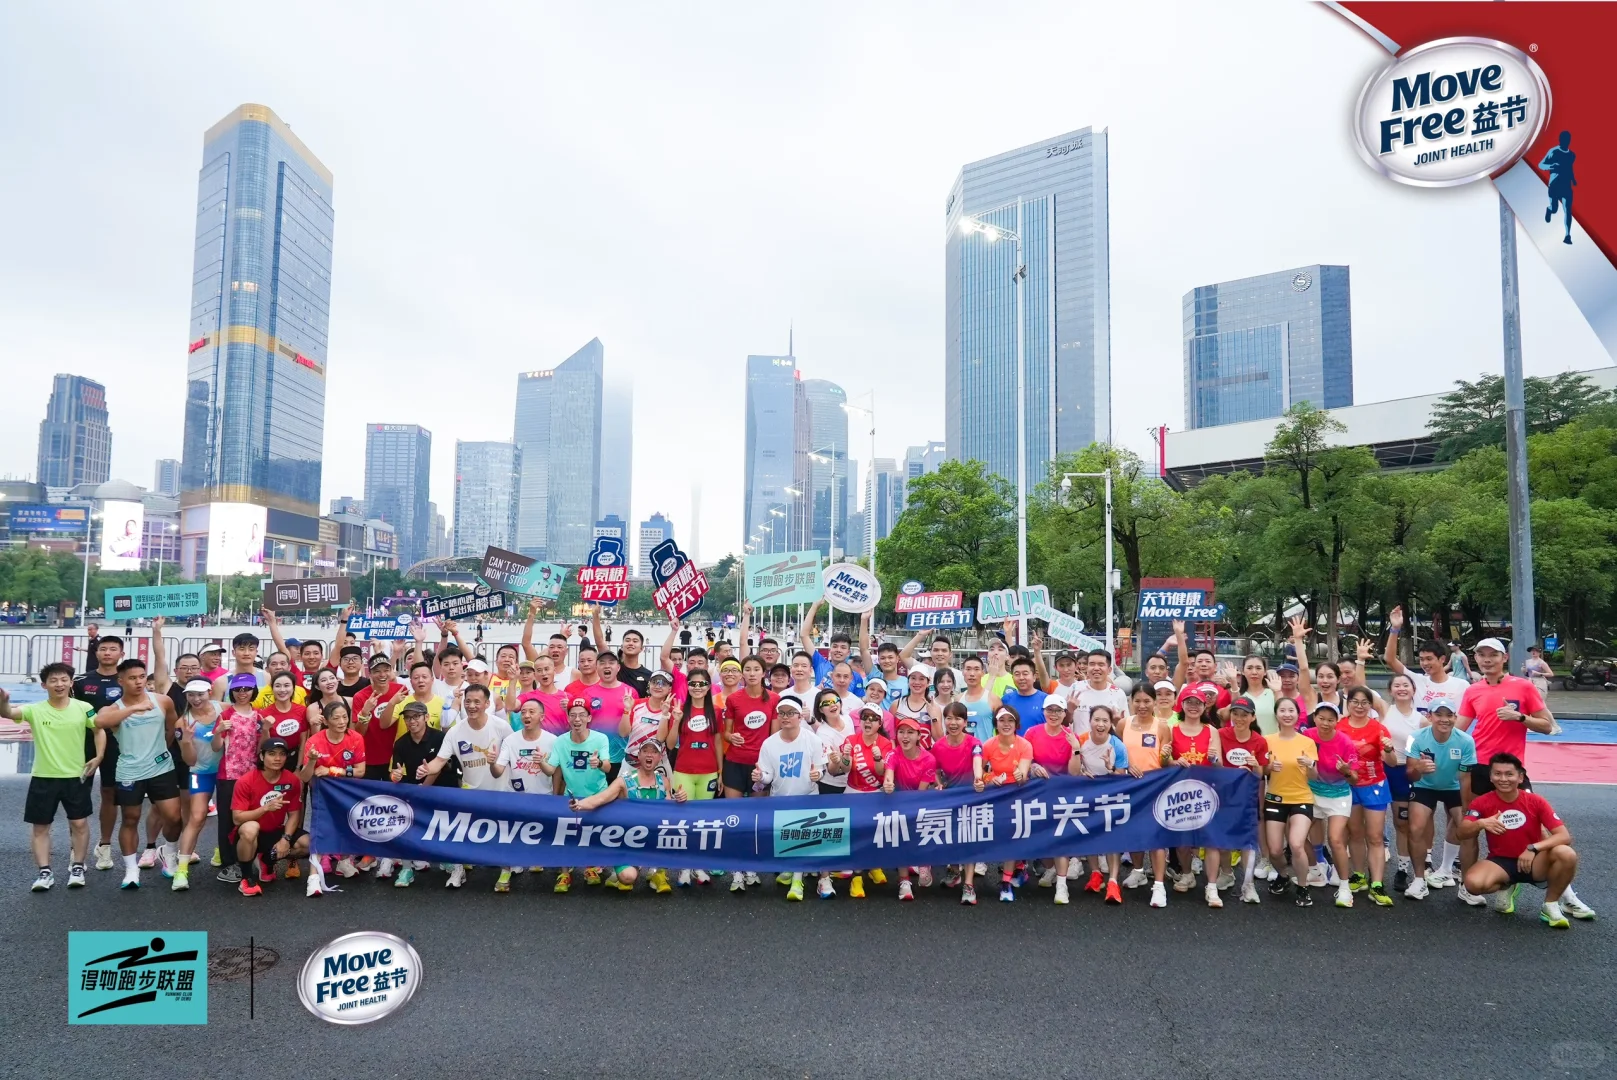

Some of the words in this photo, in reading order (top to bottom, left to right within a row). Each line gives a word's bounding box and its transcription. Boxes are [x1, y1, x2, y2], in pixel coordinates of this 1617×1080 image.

[488, 556, 512, 570] CAN'T
[510, 563, 530, 576] STOP
[484, 567, 510, 582] WON'T
[508, 574, 528, 588] STOP
[752, 572, 816, 588] 得物跑步联盟
[836, 571, 868, 591] Move
[279, 590, 298, 600] 得物
[303, 583, 338, 602] 得物
[584, 583, 628, 598] 护关节
[666, 574, 708, 620] 护关节
[826, 578, 858, 596] Free
[855, 590, 874, 602] 益节
[1142, 592, 1202, 606] 关节健康
[136, 602, 151, 610] CAN'T
[152, 602, 166, 610] STOP
[186, 600, 199, 608] STOP
[898, 594, 958, 610] 随心而动
[982, 593, 1020, 620] ALL
[1022, 590, 1046, 614] IN
[910, 610, 972, 627] 自在益节
[1034, 606, 1060, 624] CAN'T
[1060, 614, 1082, 631] STOP
[1140, 606, 1181, 618] Move
[1051, 626, 1079, 644] WON'T
[1167, 788, 1203, 806] Move
[360, 804, 398, 817] Move
[1164, 804, 1192, 822] Free
[1194, 801, 1212, 813] 益节
[1502, 812, 1518, 820] Move
[356, 816, 386, 830] Free
[386, 814, 406, 827] 益节
[421, 810, 544, 845] Move
[551, 816, 650, 848] Free
[872, 802, 994, 848] 补氨糖
[1011, 792, 1131, 840] 护关节
[780, 827, 844, 841] 得物跑步联盟
